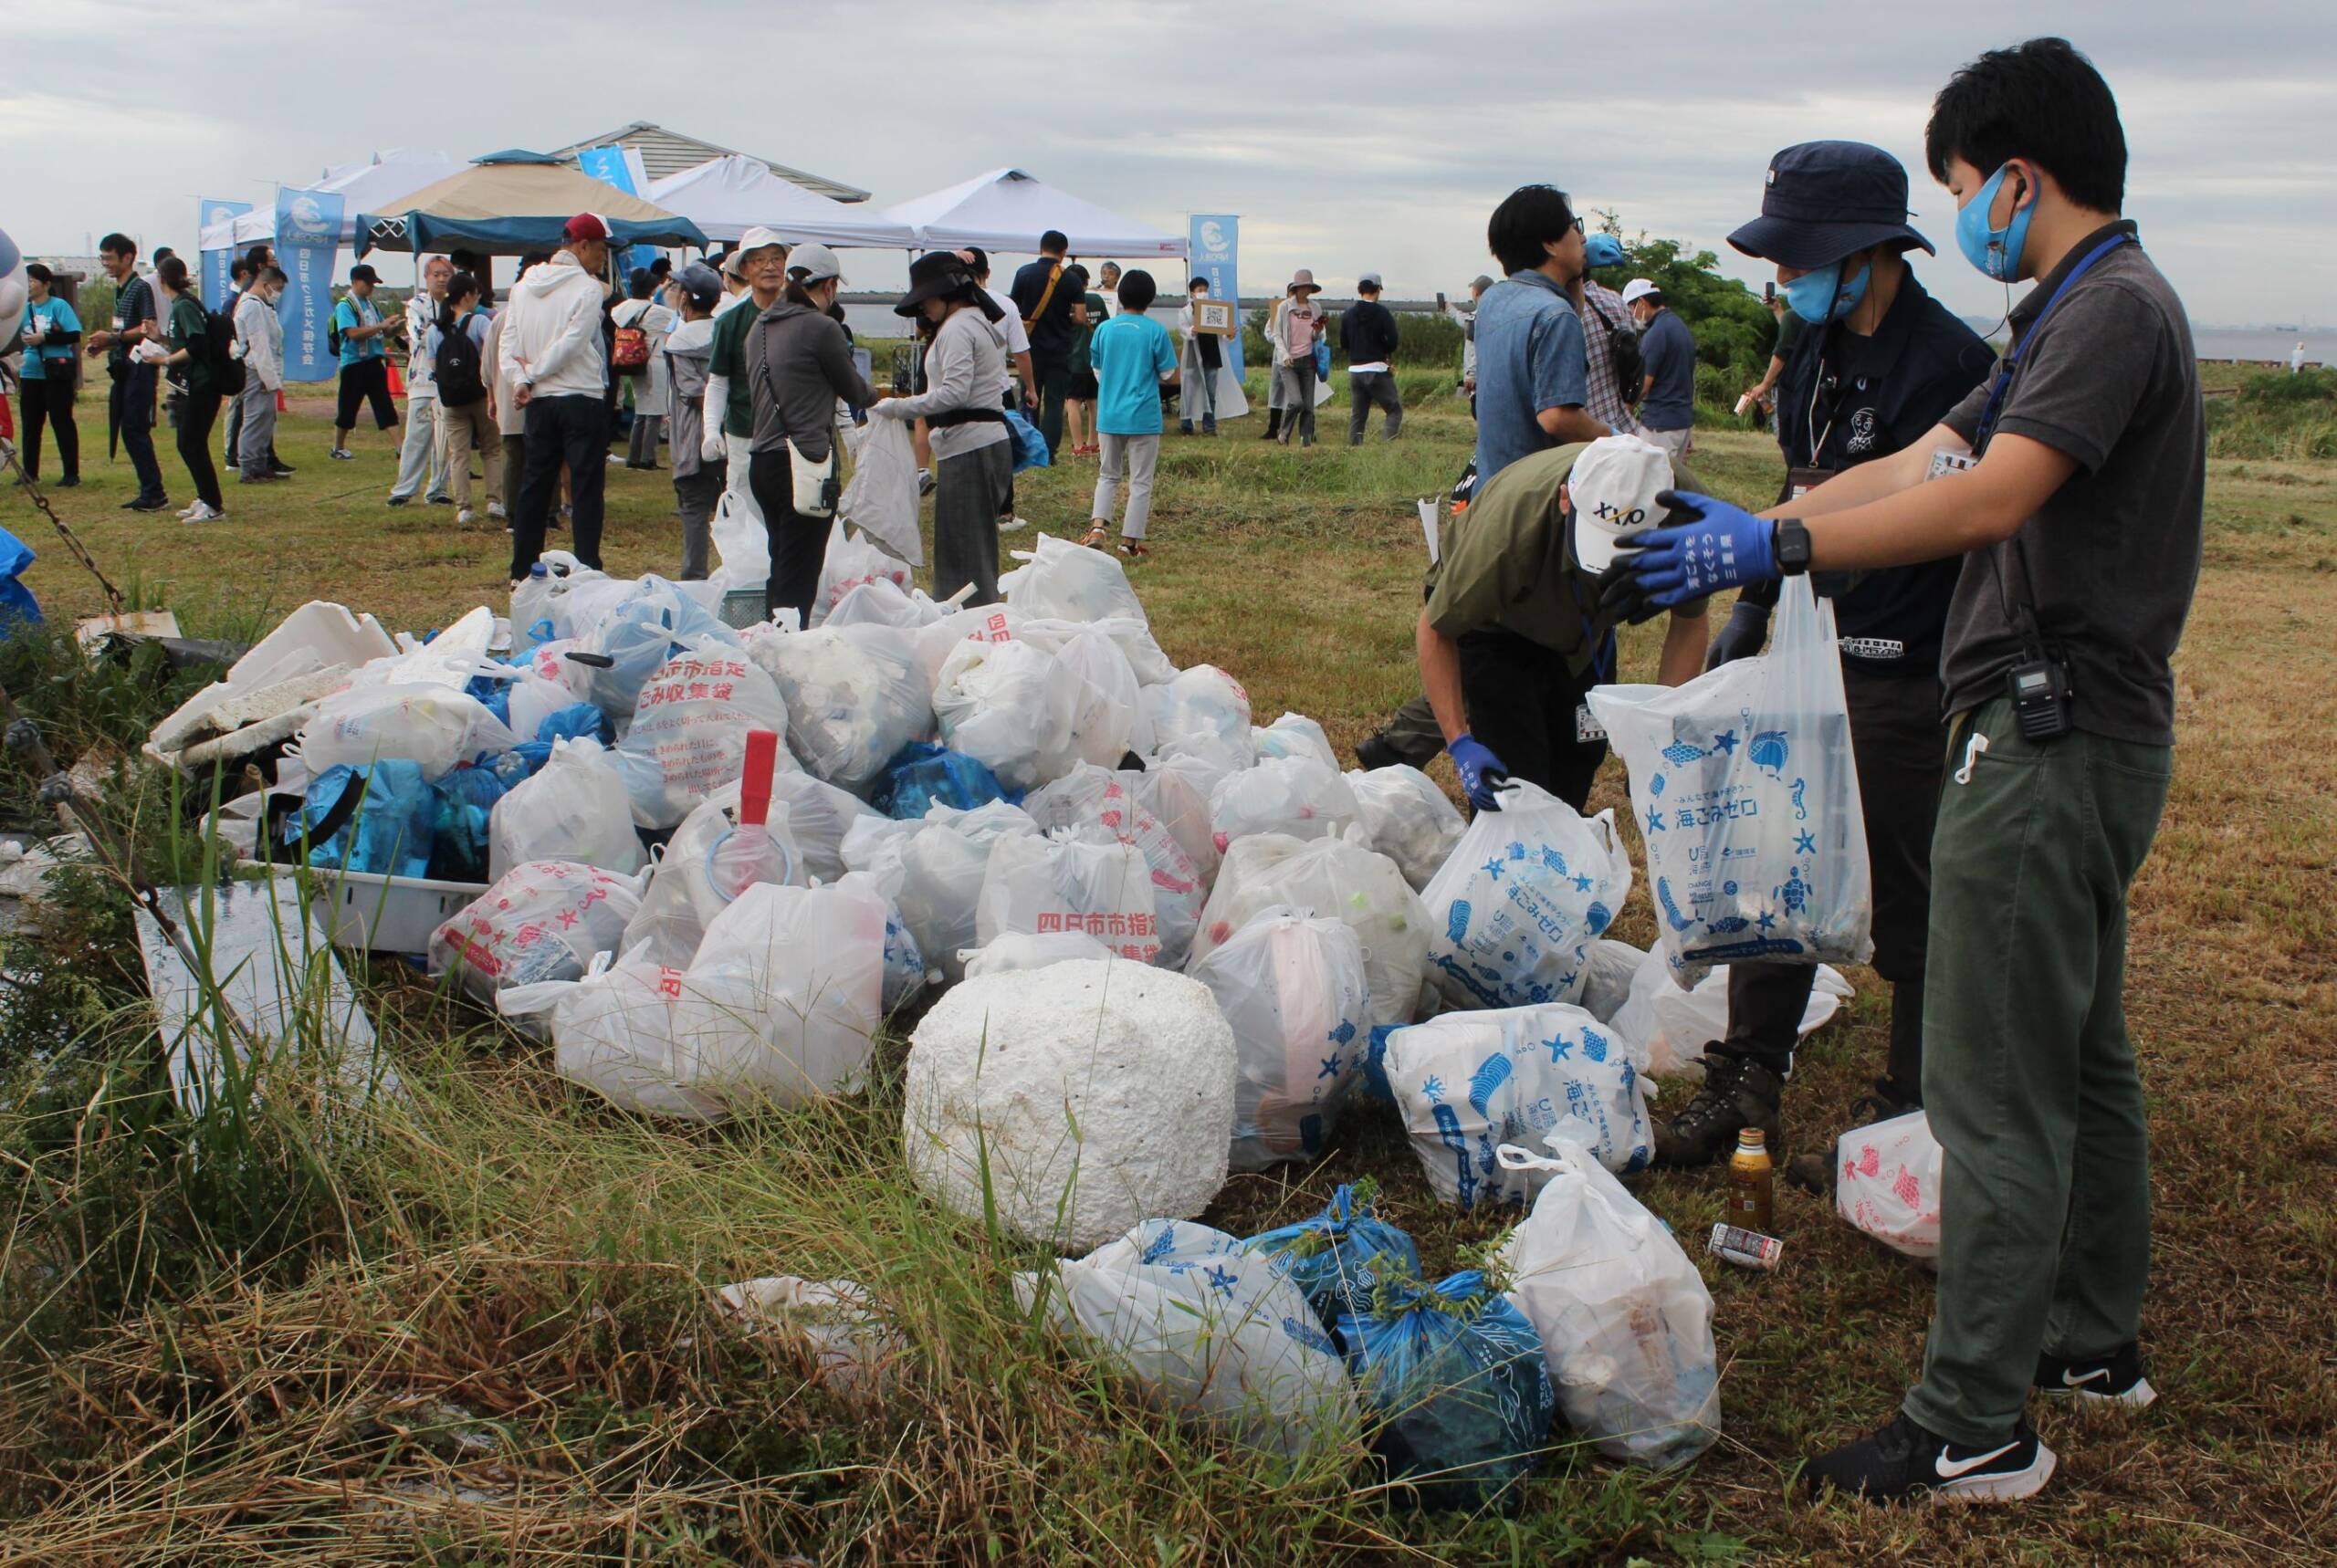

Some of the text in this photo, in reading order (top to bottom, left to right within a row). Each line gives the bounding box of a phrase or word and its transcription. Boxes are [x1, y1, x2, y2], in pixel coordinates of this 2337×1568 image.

[1674, 799, 1758, 830] 海ごみゼロ
[1504, 879, 1564, 943] 海ごみゼロ
